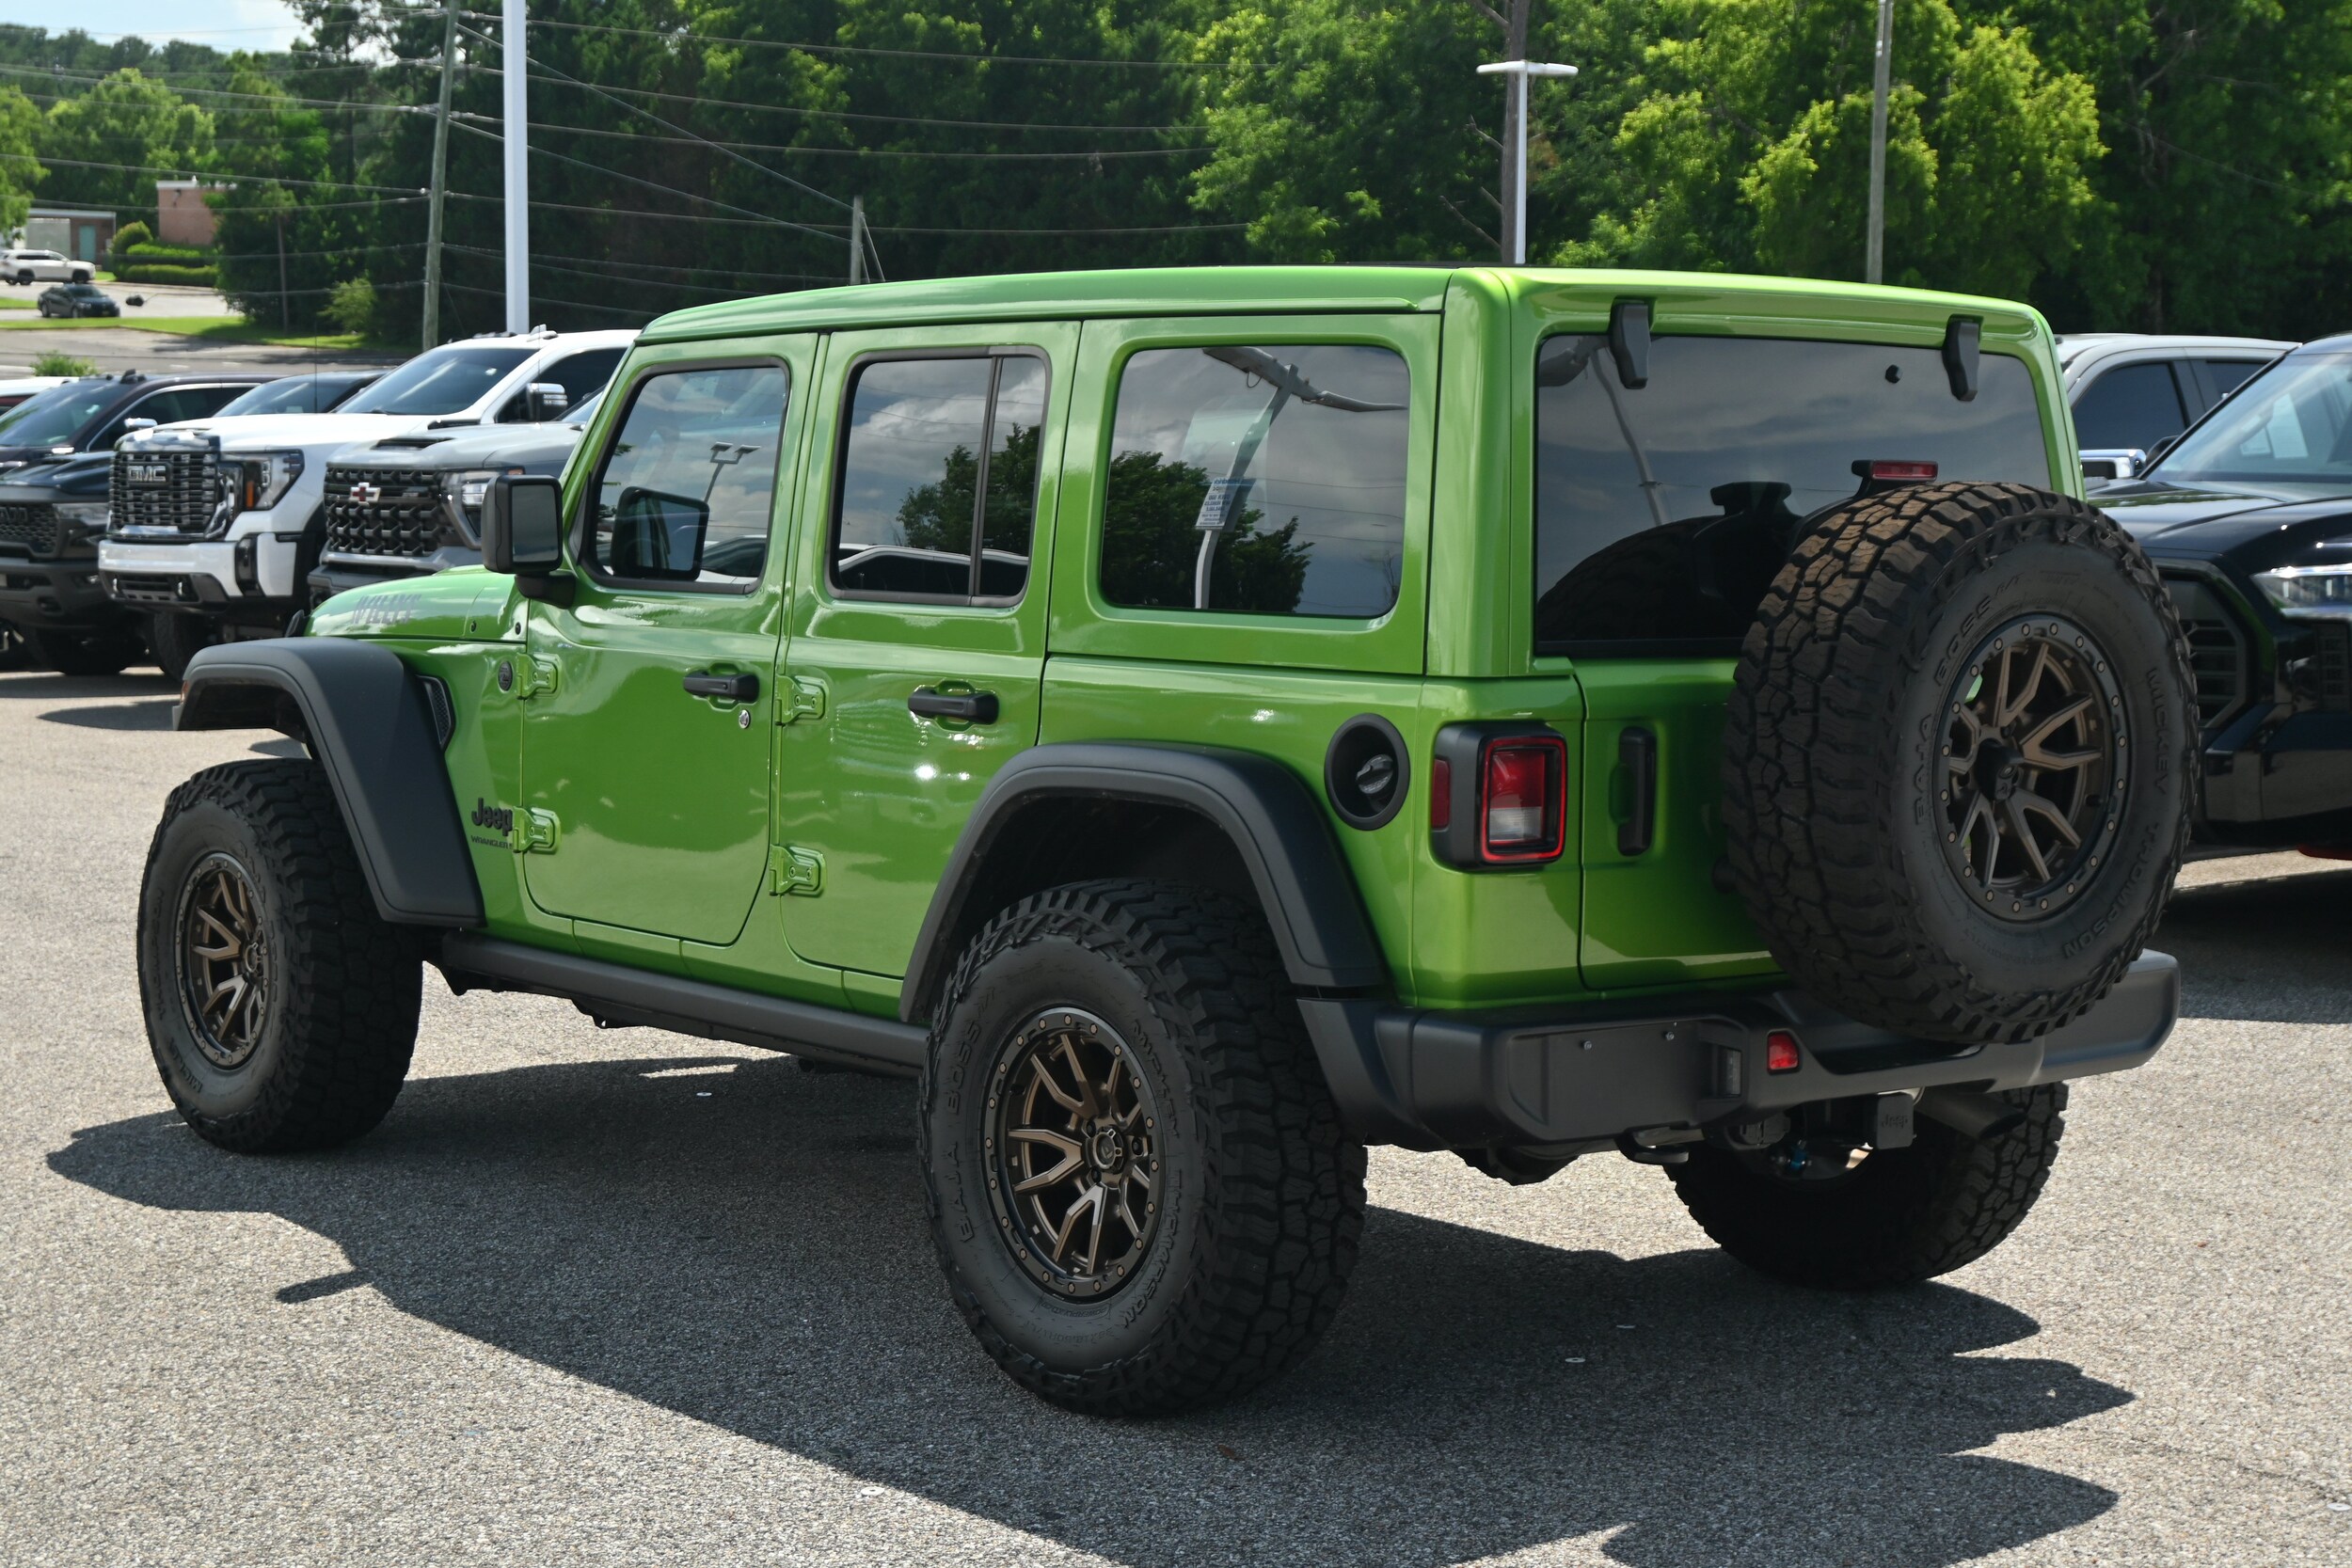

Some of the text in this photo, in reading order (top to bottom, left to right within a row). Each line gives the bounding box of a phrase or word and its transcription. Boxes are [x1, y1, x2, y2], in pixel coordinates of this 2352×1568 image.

[128, 466, 167, 483] GMC
[352, 594, 422, 625] WILLYS
[1913, 713, 1933, 826] BAJA
[1934, 595, 1993, 686] BOSS
[470, 797, 514, 837] Jeep
[470, 834, 509, 850] WRANGLER
[2062, 666, 2171, 959] MICKEY THOMPSON
[946, 1021, 983, 1117] BOSS
[1881, 1113, 1909, 1129] Jeep
[947, 1140, 976, 1243] BAJA
[1121, 1019, 1183, 1330] MICKEY THOMPSON
